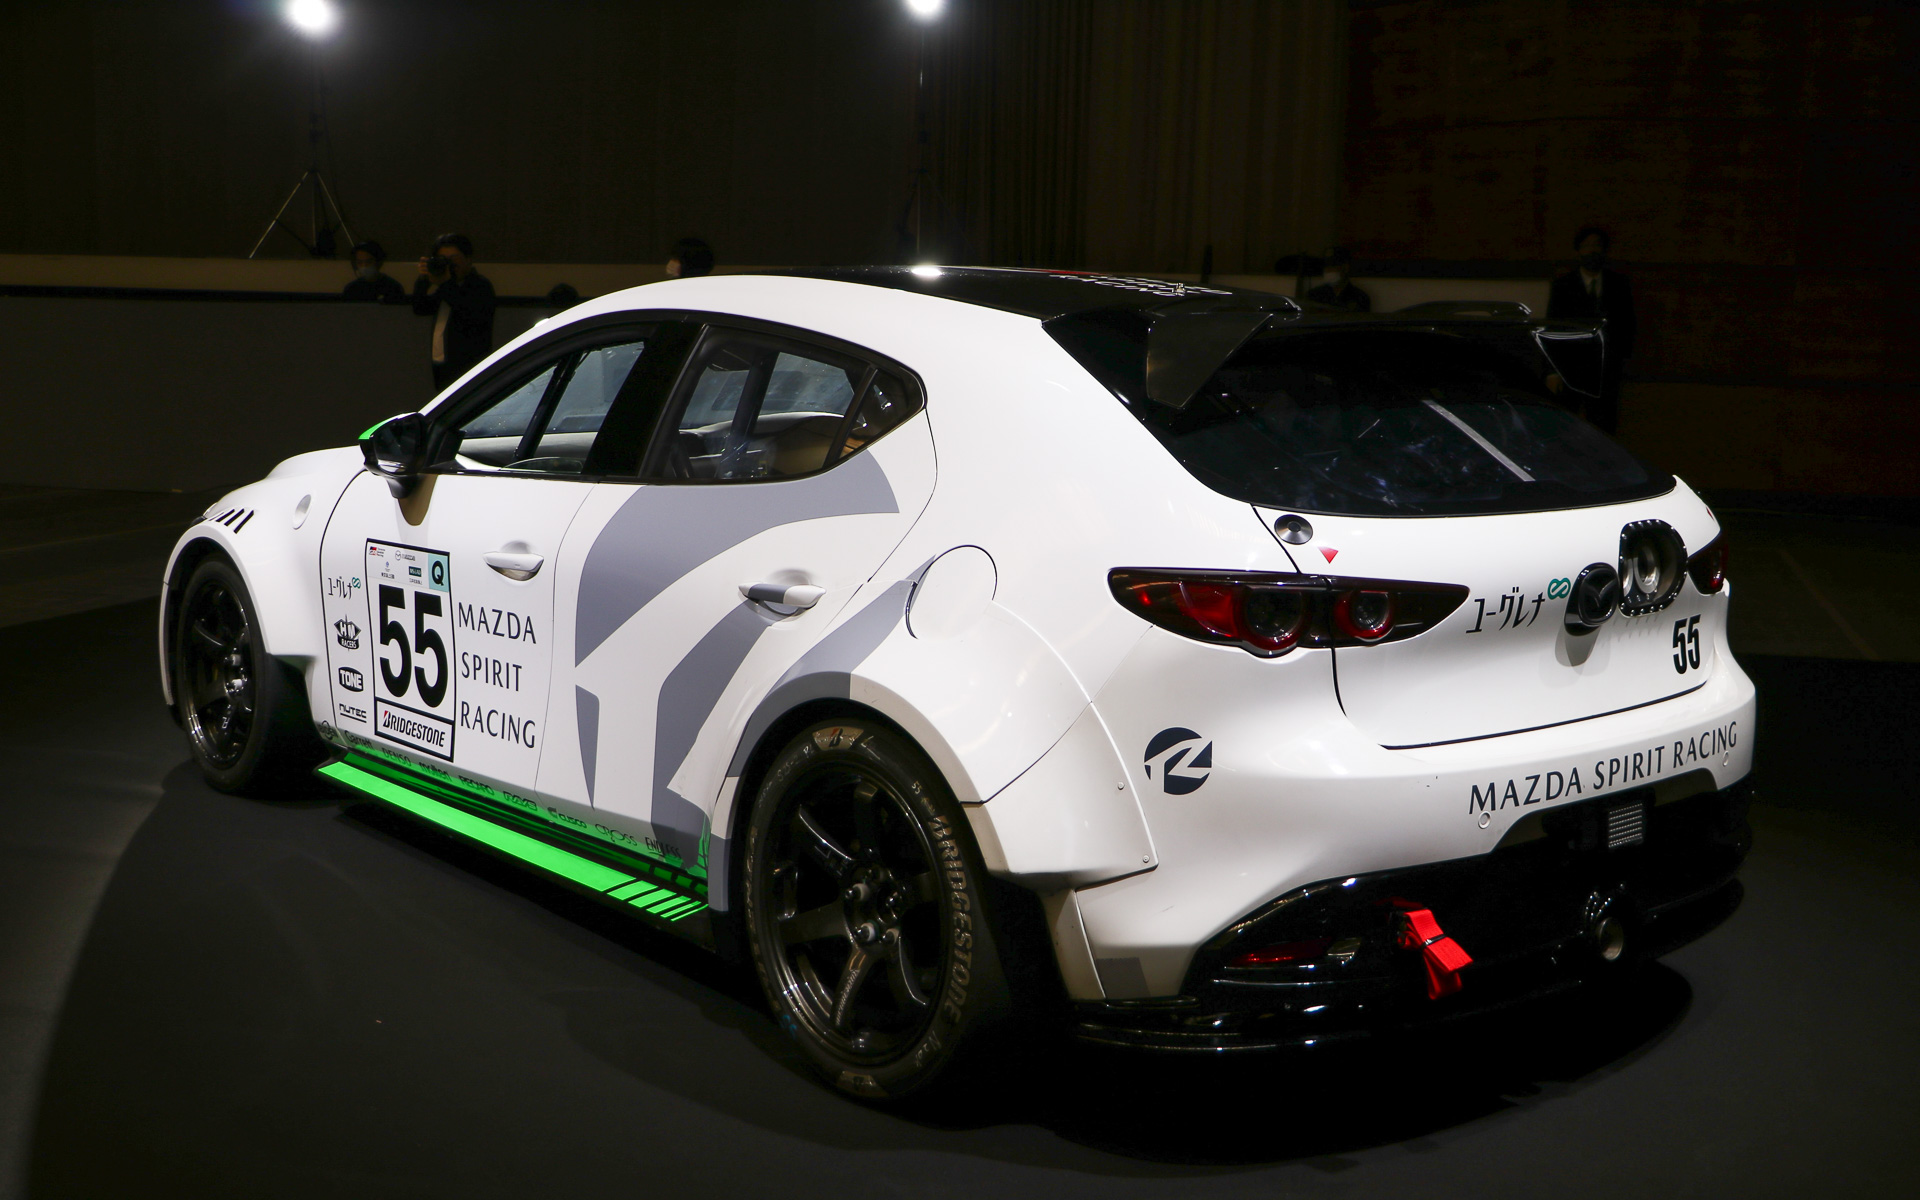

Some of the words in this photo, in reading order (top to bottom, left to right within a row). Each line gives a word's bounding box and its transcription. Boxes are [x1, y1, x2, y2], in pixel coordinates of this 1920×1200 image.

[328, 576, 353, 600] ユーグレナ
[431, 560, 445, 587] Q
[458, 602, 537, 644] MAZDA
[1465, 586, 1546, 634] ユーグレナ
[379, 584, 448, 708] 55
[1672, 614, 1701, 675] 55
[340, 670, 362, 690] TONE
[461, 652, 523, 692] SPIRIT
[383, 710, 446, 748] BRIDGESTONE
[460, 701, 536, 749] RACING
[1469, 766, 1582, 815] MAZDA
[1593, 745, 1665, 790] SPIRIT
[1673, 721, 1738, 768] RACING
[931, 815, 972, 1023] BRIDGESTONE
